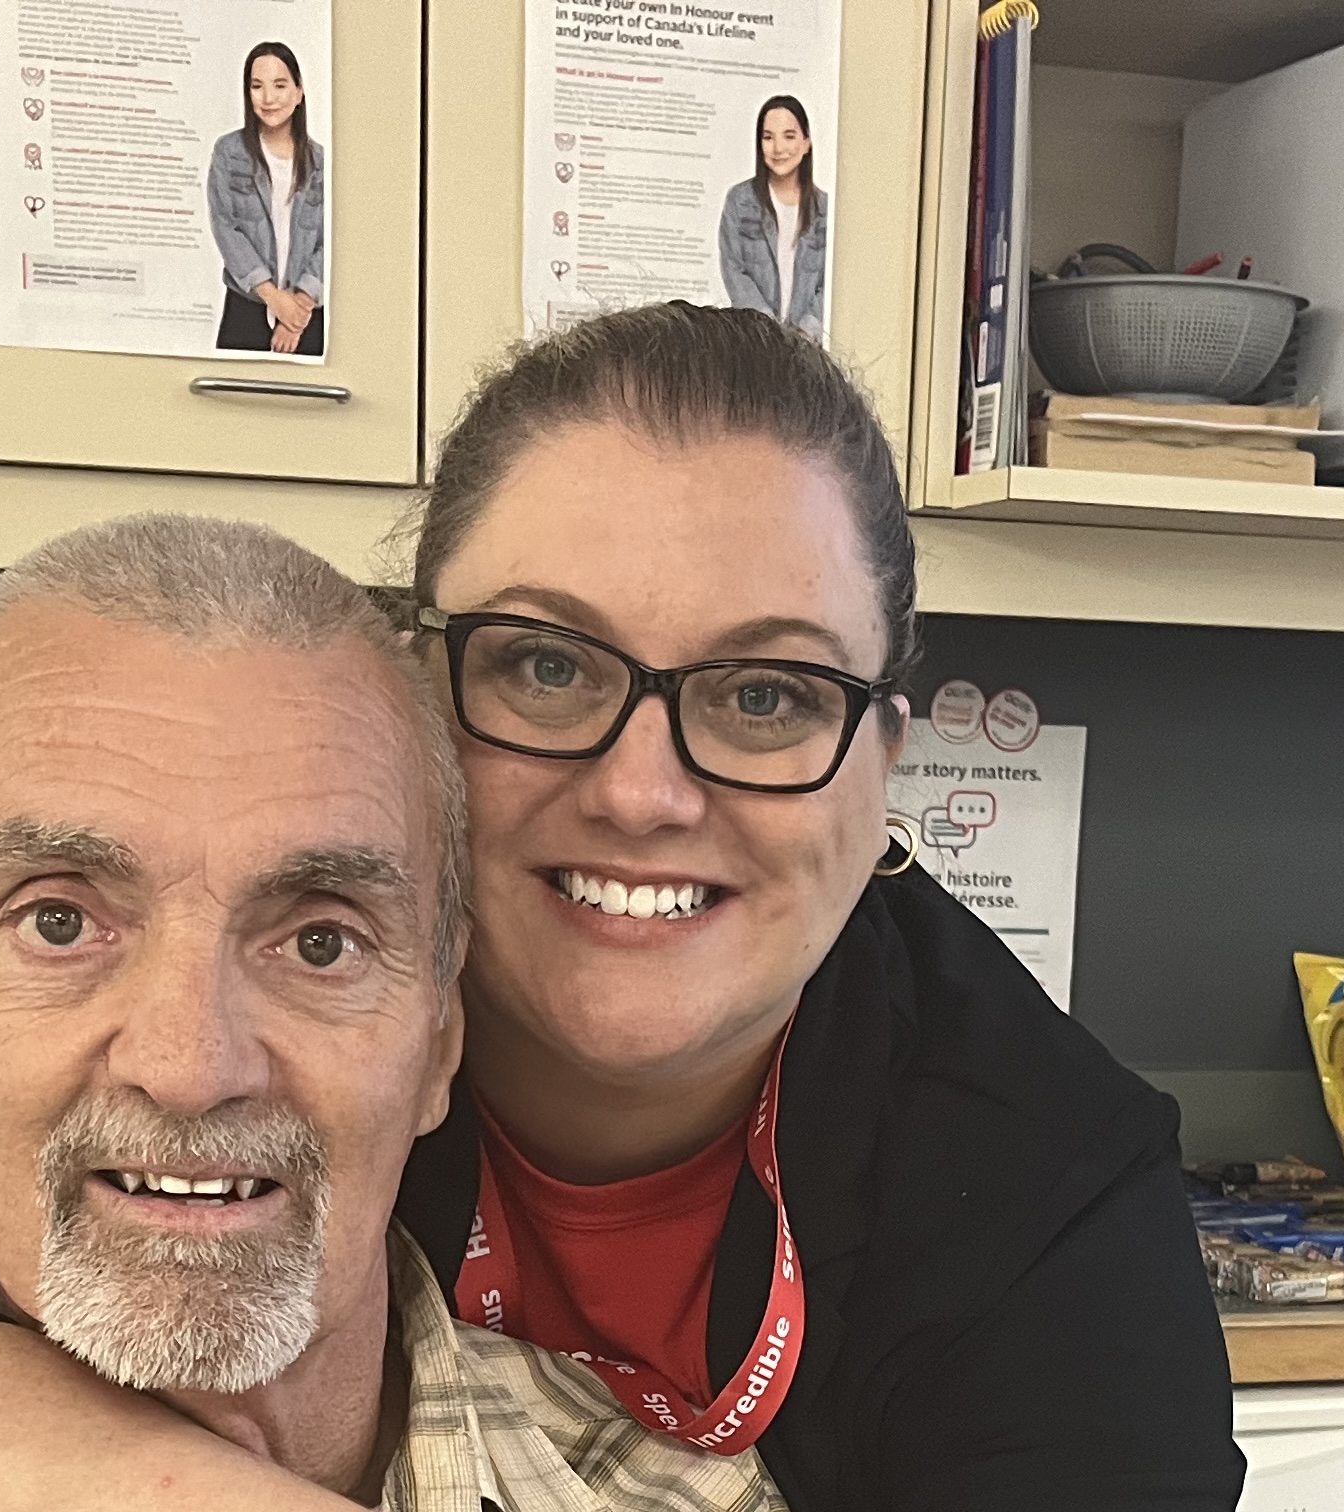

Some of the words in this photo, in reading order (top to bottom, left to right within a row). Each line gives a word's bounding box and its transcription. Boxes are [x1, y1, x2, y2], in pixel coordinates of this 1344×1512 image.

[556, 8, 567, 20] in
[572, 13, 623, 27] support
[628, 16, 640, 27] of
[645, 17, 703, 34] Canada's
[707, 23, 755, 39] Lifeline
[639, 3, 666, 13] own
[686, 5, 733, 21] Honour
[738, 13, 773, 25] event
[556, 26, 580, 37] and
[584, 30, 613, 42] your
[617, 30, 652, 45] loved
[890, 764, 920, 776] our
[923, 763, 967, 781] story
[971, 765, 1042, 781] matters.
[947, 870, 1012, 888] histoire
[687, 1316, 790, 1449] Incredible
[642, 1393, 678, 1430] Spe
